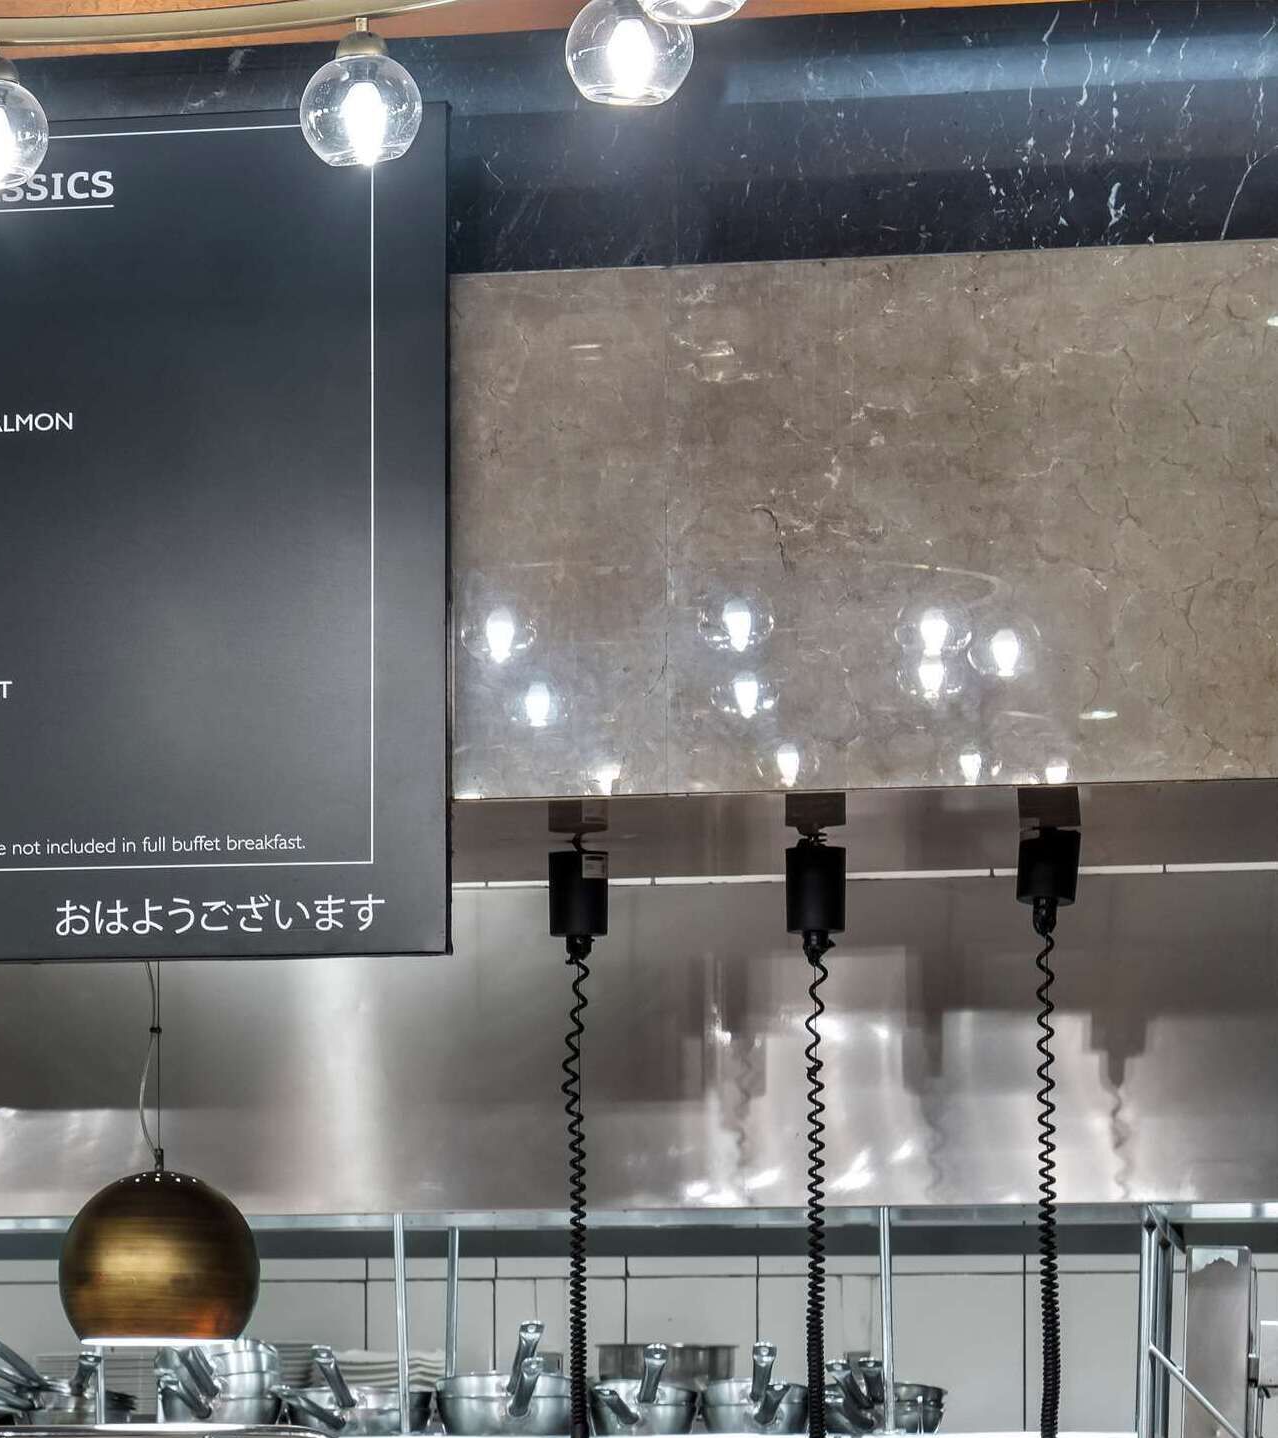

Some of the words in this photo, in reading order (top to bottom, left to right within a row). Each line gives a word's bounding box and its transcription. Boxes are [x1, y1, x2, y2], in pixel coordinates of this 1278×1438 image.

[12, 840, 42, 856] not
[46, 837, 116, 855] included
[122, 841, 137, 853] in
[141, 835, 166, 853] full
[172, 834, 222, 852] buffet
[226, 833, 306, 851] breakfast.
[55, 893, 386, 937] おはようございます
